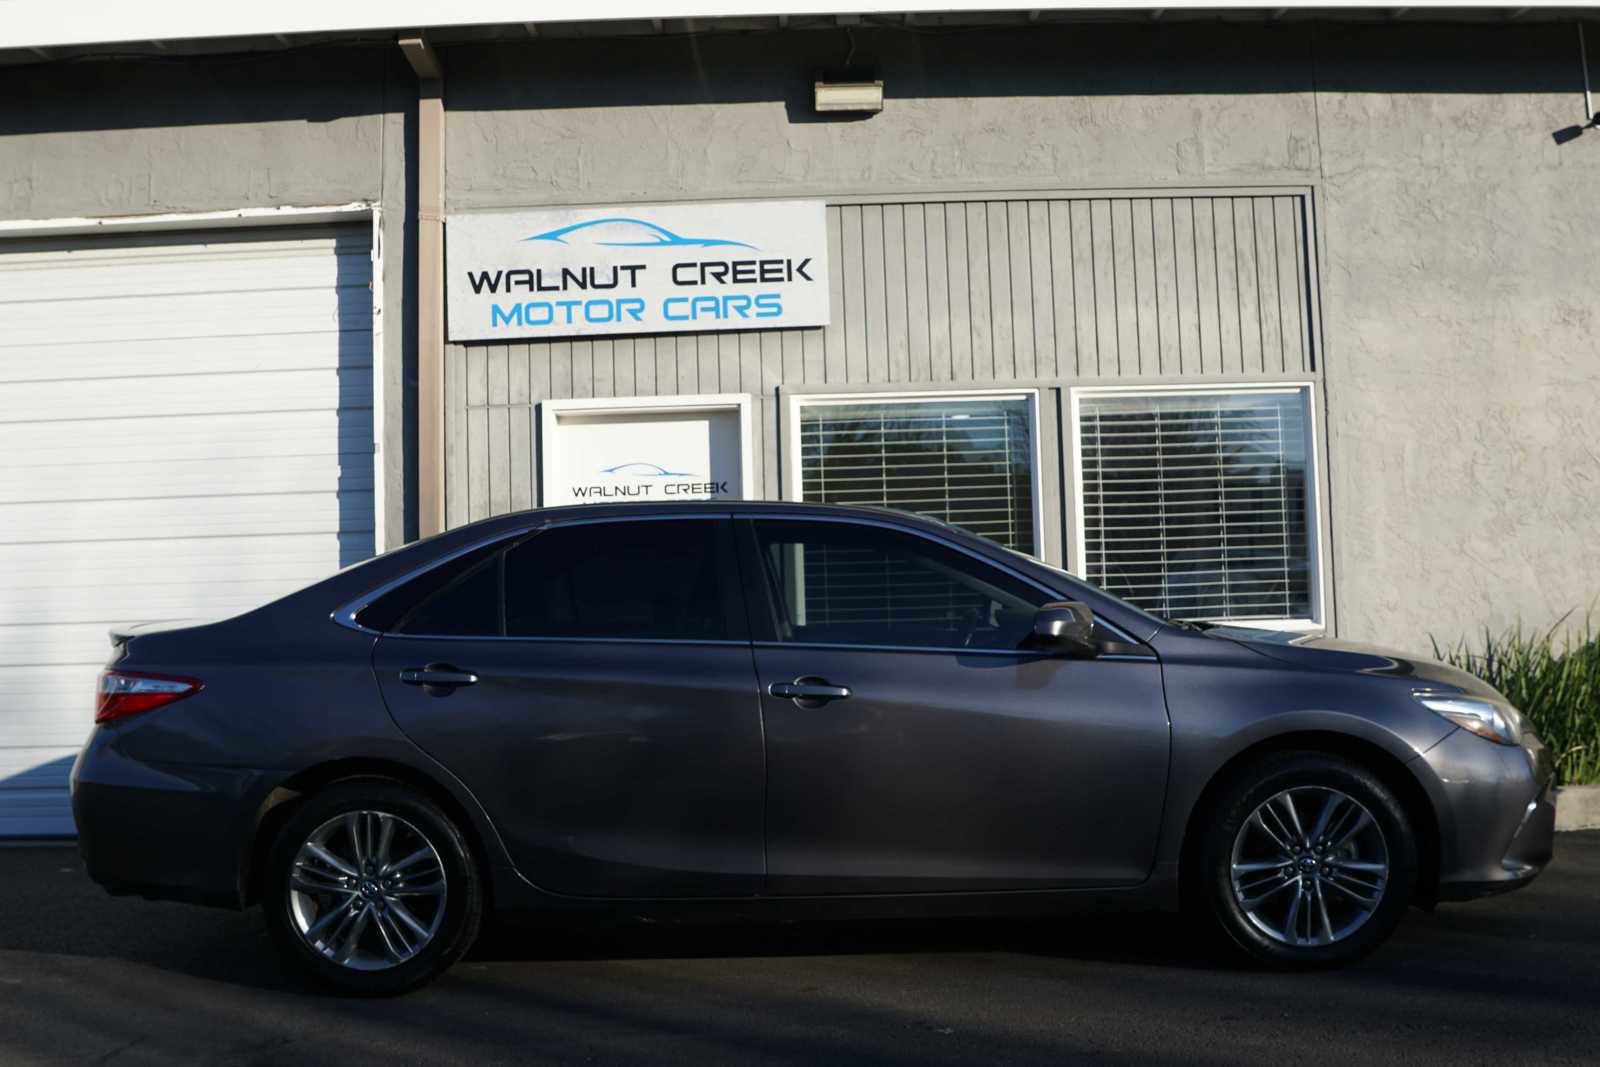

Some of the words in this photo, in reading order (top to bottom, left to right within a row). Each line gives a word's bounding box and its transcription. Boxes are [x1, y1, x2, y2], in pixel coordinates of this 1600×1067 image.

[467, 264, 647, 295] WALNUT
[671, 257, 814, 287] CREEK
[491, 298, 646, 328] MOTOR
[662, 293, 784, 322] CARS
[572, 484, 653, 498] WALNUT
[664, 481, 729, 495] CREEK
